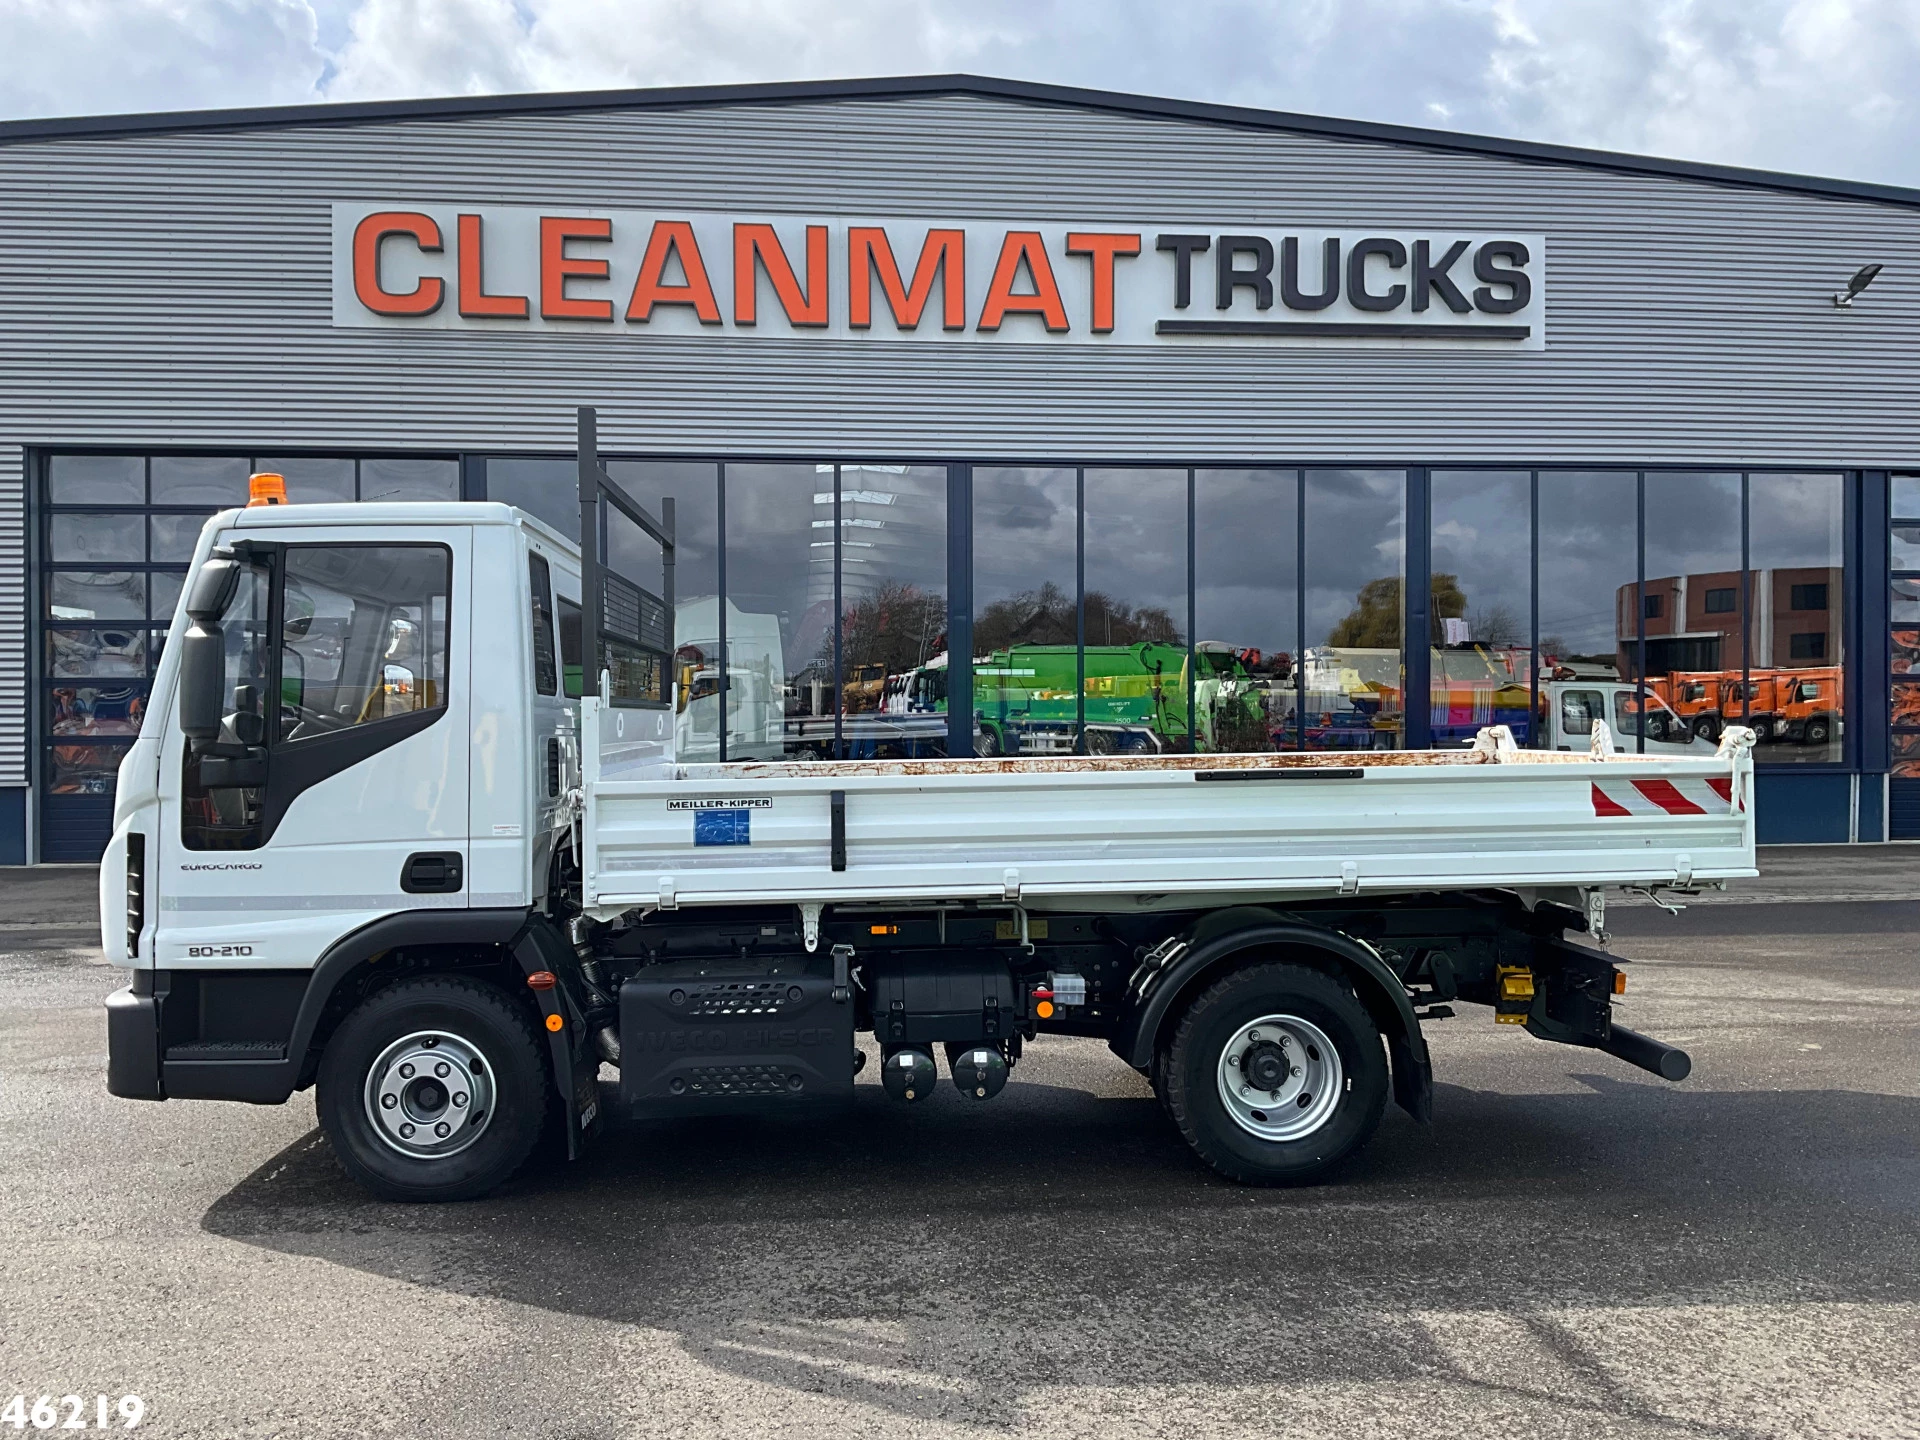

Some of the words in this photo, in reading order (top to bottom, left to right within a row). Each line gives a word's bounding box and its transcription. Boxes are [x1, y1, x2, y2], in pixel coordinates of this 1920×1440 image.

[352, 211, 1141, 333] CLEANMAT
[1155, 234, 1532, 314] TRUCKS
[669, 799, 770, 809] MEILLER-KIPPER
[180, 863, 263, 871] EUROCARGO
[188, 946, 253, 958] 80-210
[635, 1029, 729, 1052] IVECO
